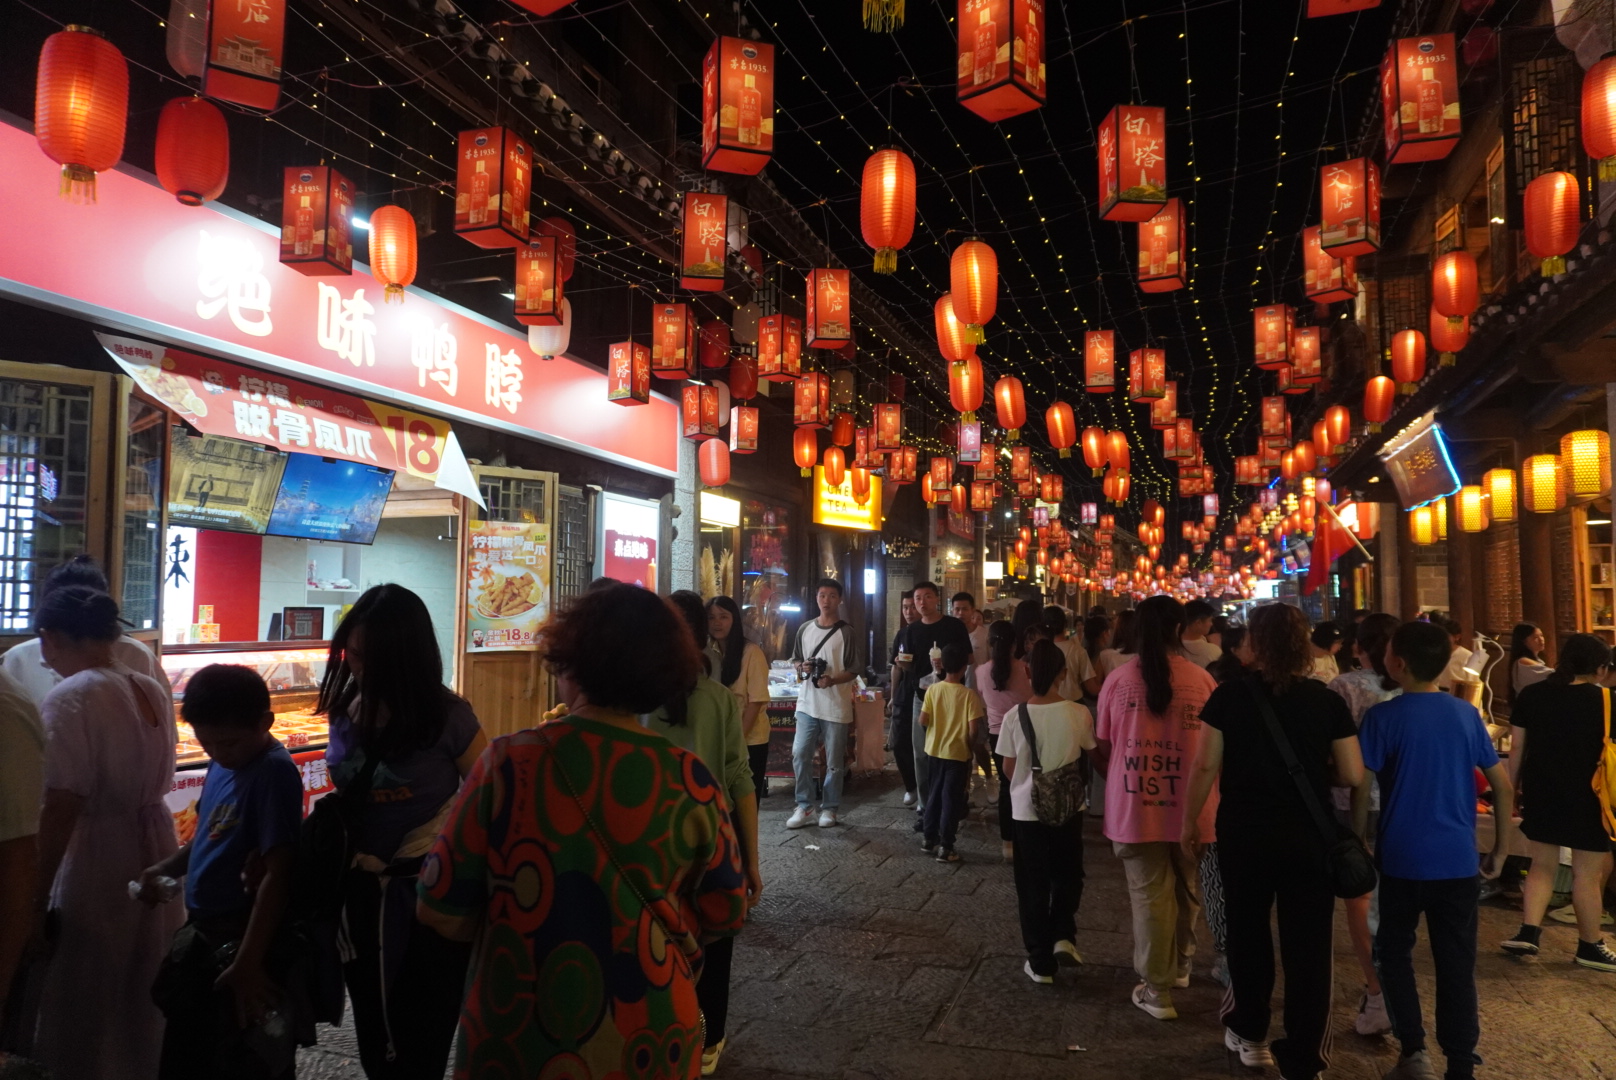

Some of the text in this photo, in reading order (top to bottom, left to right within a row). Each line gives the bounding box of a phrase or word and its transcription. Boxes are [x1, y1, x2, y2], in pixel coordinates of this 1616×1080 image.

[195, 229, 524, 415] 绝味鸭脖
[238, 373, 291, 409] 柠檬
[232, 400, 377, 462] 脱骨凤爪
[386, 415, 440, 475] 18
[827, 499, 848, 513] TEA
[1126, 738, 1183, 752] CHANEL
[299, 758, 328, 793] 檬
[1124, 754, 1182, 772] WISH
[1124, 774, 1182, 796] LIST
